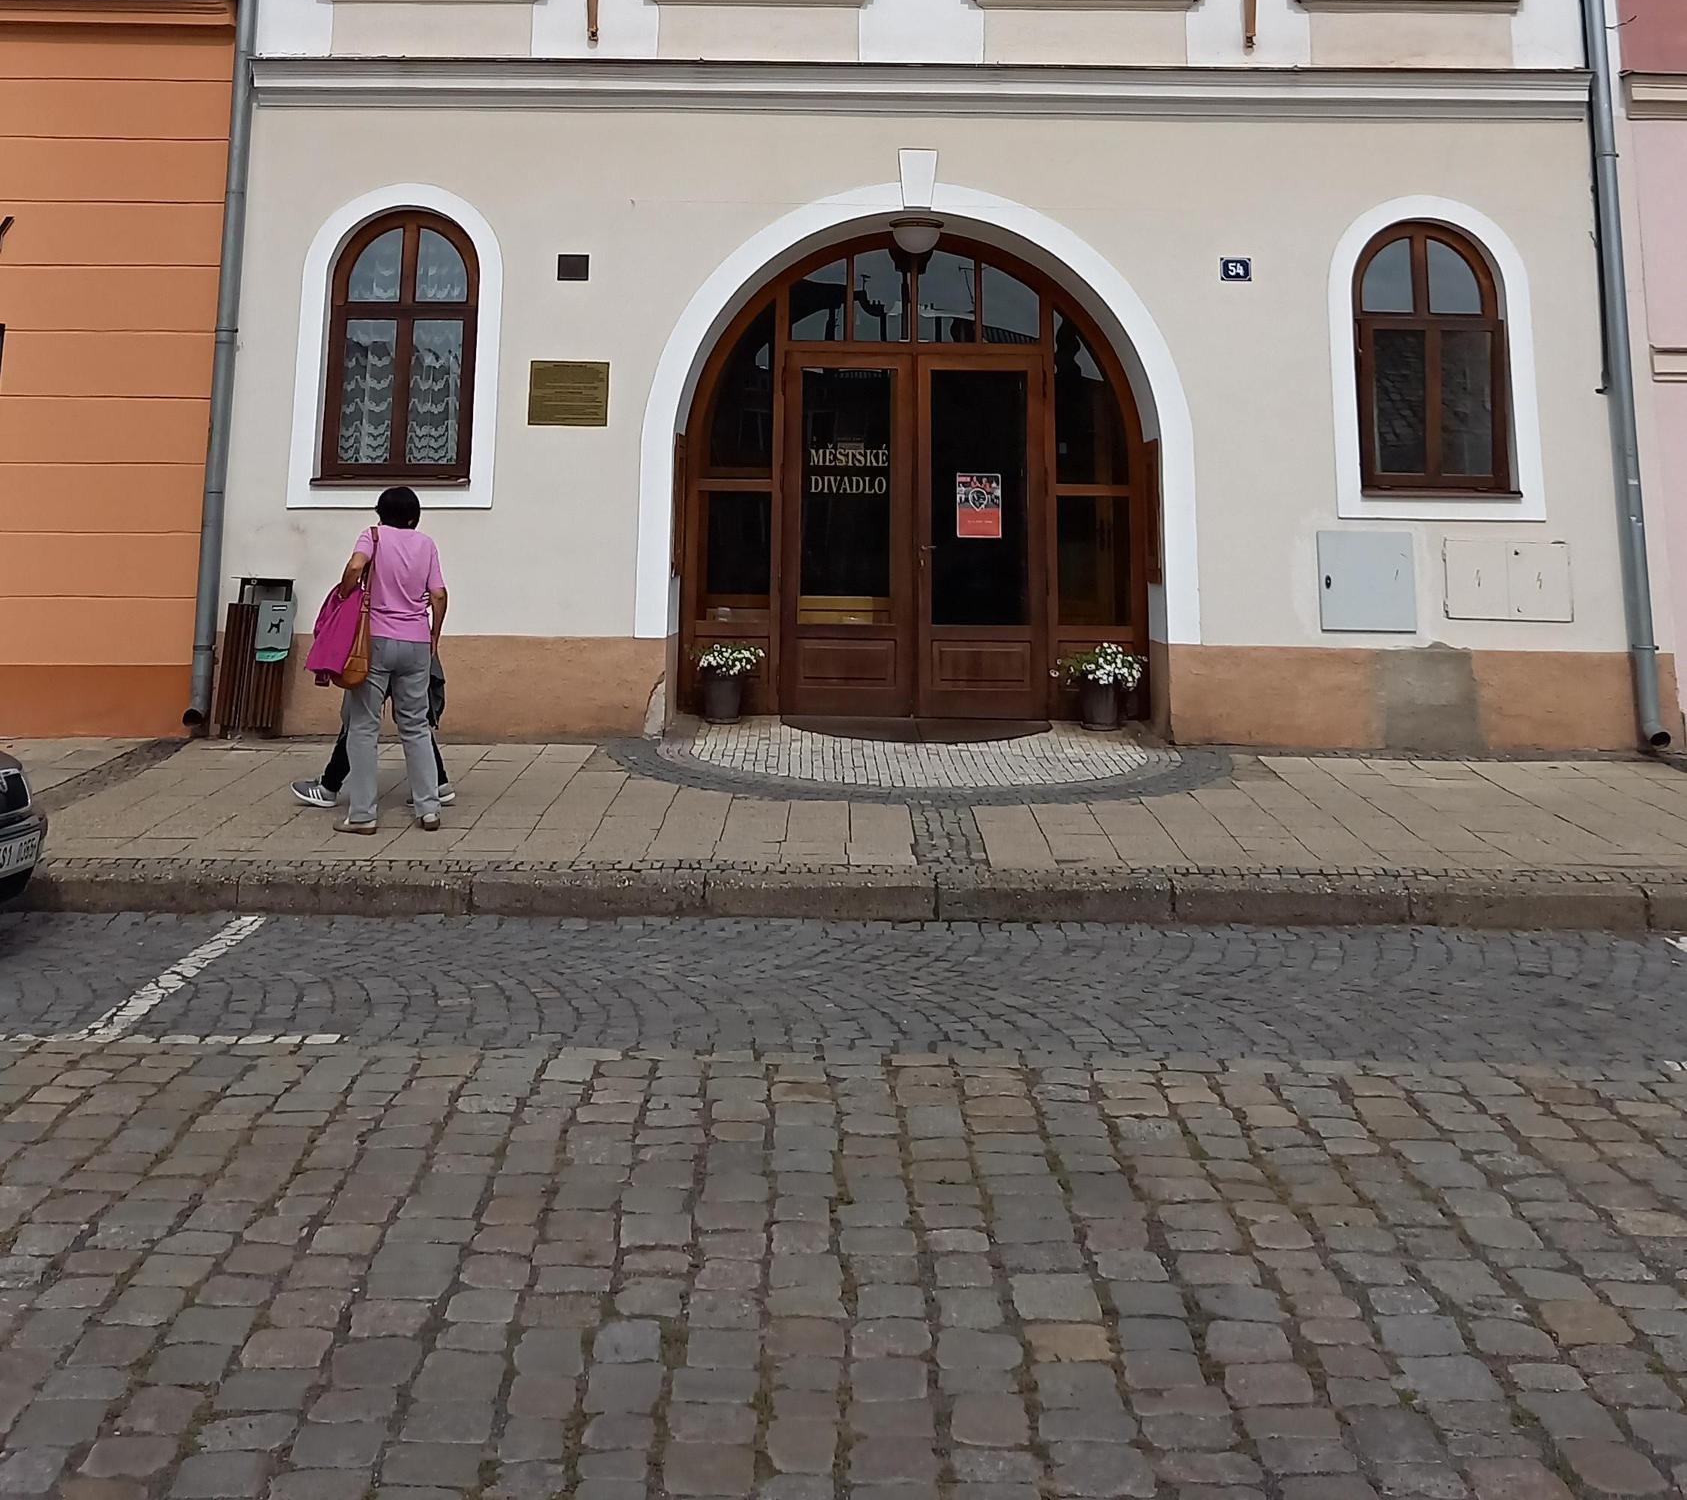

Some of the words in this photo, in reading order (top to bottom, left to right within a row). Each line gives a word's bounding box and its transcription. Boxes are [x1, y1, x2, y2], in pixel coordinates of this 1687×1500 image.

[1228, 262, 1244, 276] 54
[809, 443, 889, 467] MĚSTSKÉ
[810, 475, 887, 494] DIVADLO
